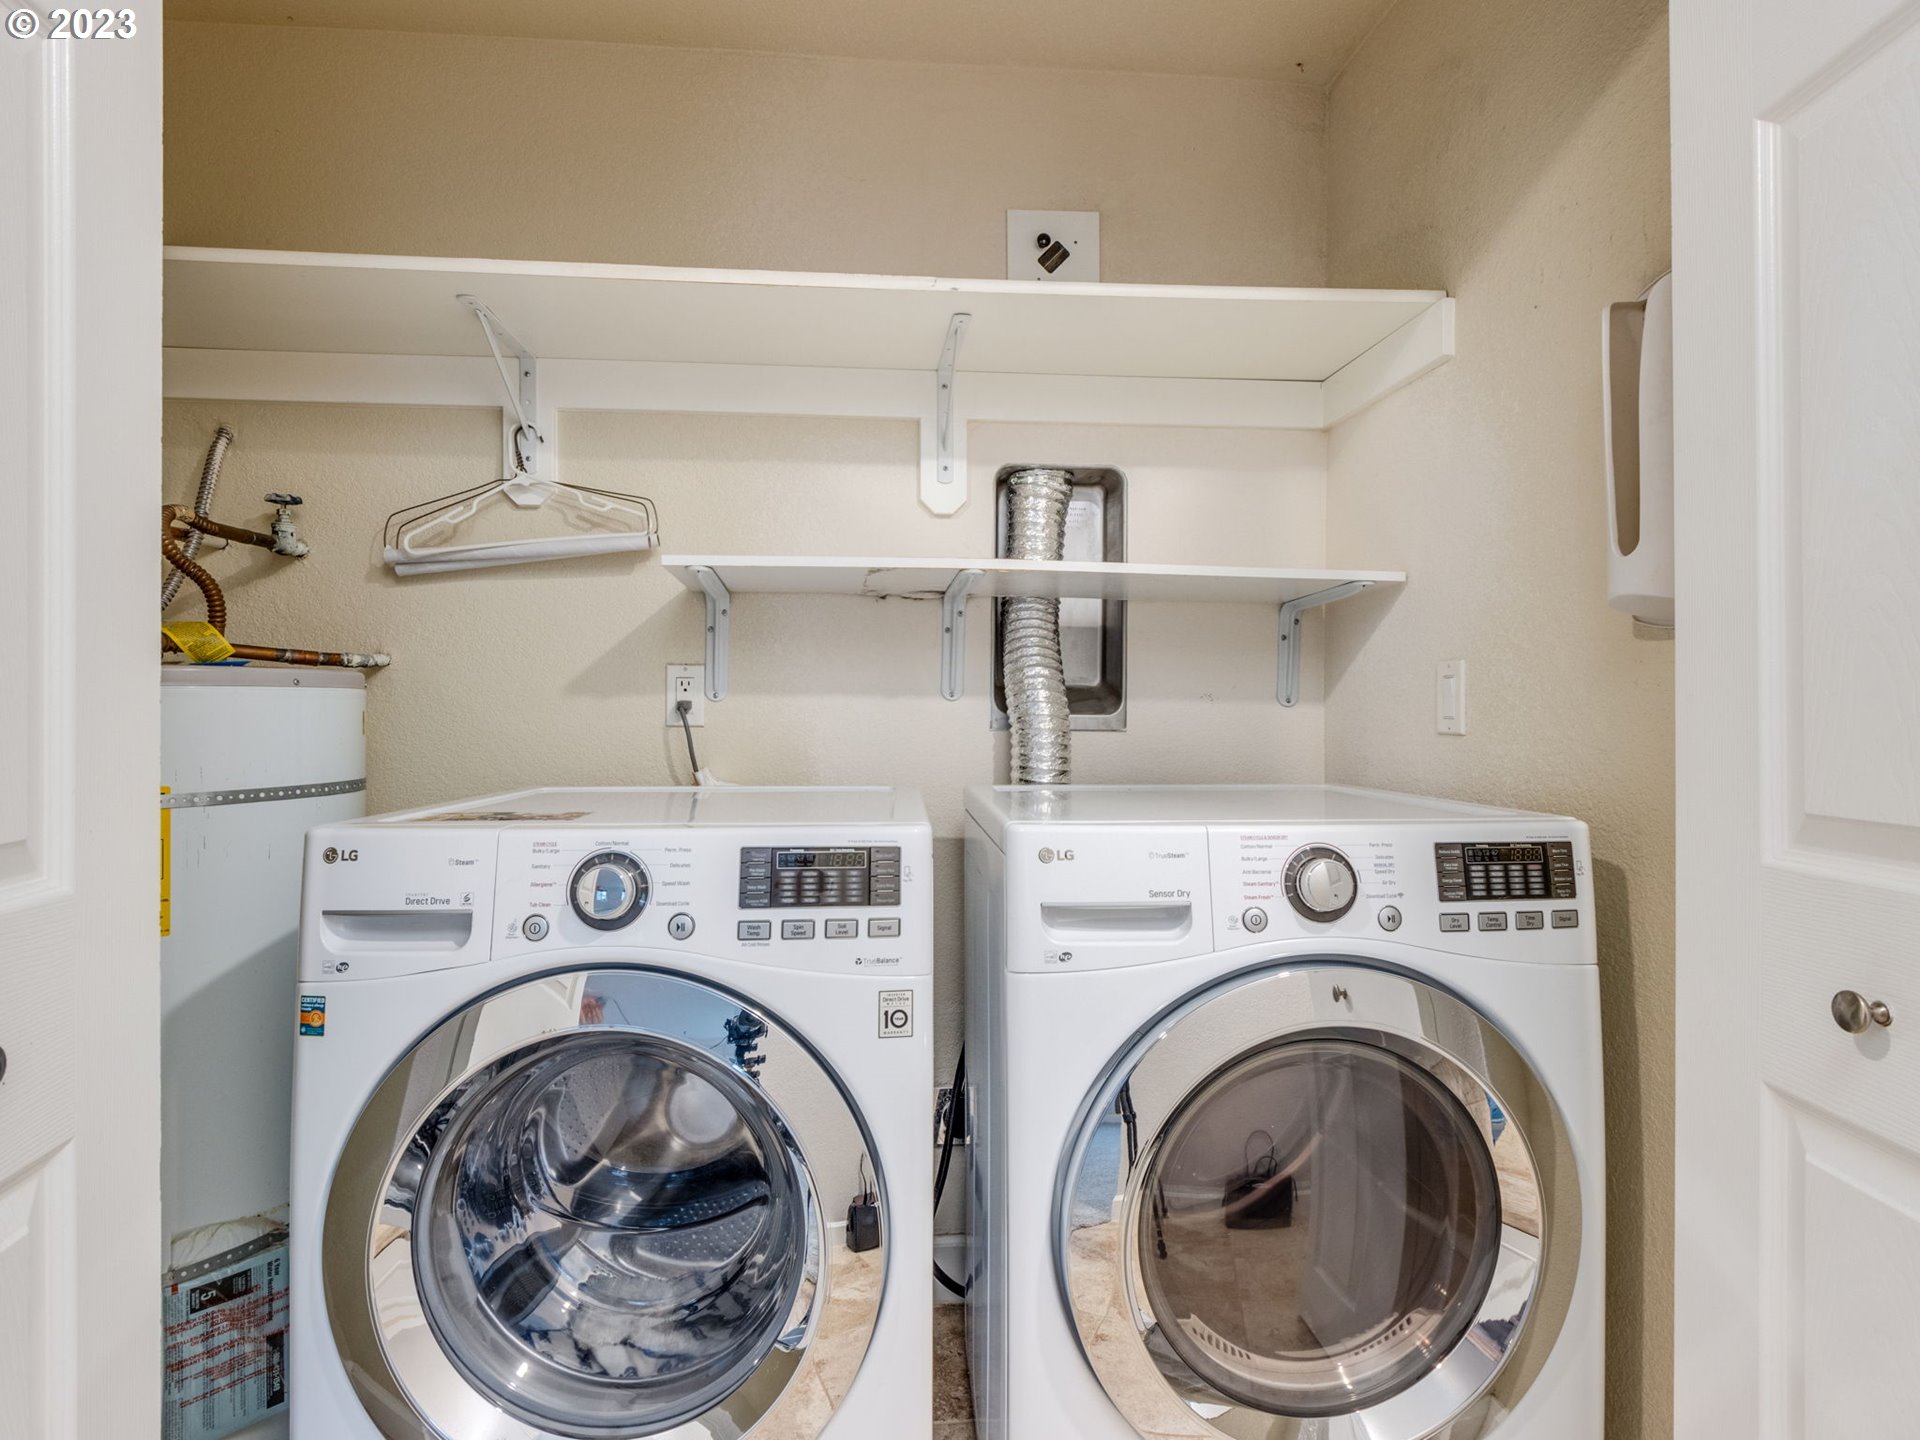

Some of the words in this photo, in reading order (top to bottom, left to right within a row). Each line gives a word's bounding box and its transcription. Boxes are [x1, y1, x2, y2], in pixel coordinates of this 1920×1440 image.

[341, 850, 358, 862] LG
[1057, 850, 1074, 861] LG
[1148, 890, 1175, 898] Sensor
[1176, 889, 1191, 899] Dry
[405, 896, 429, 905] Direct
[430, 896, 451, 905] Drive
[877, 924, 892, 932] Signal
[884, 1009, 908, 1029] 10
[200, 1289, 216, 1301] 5
